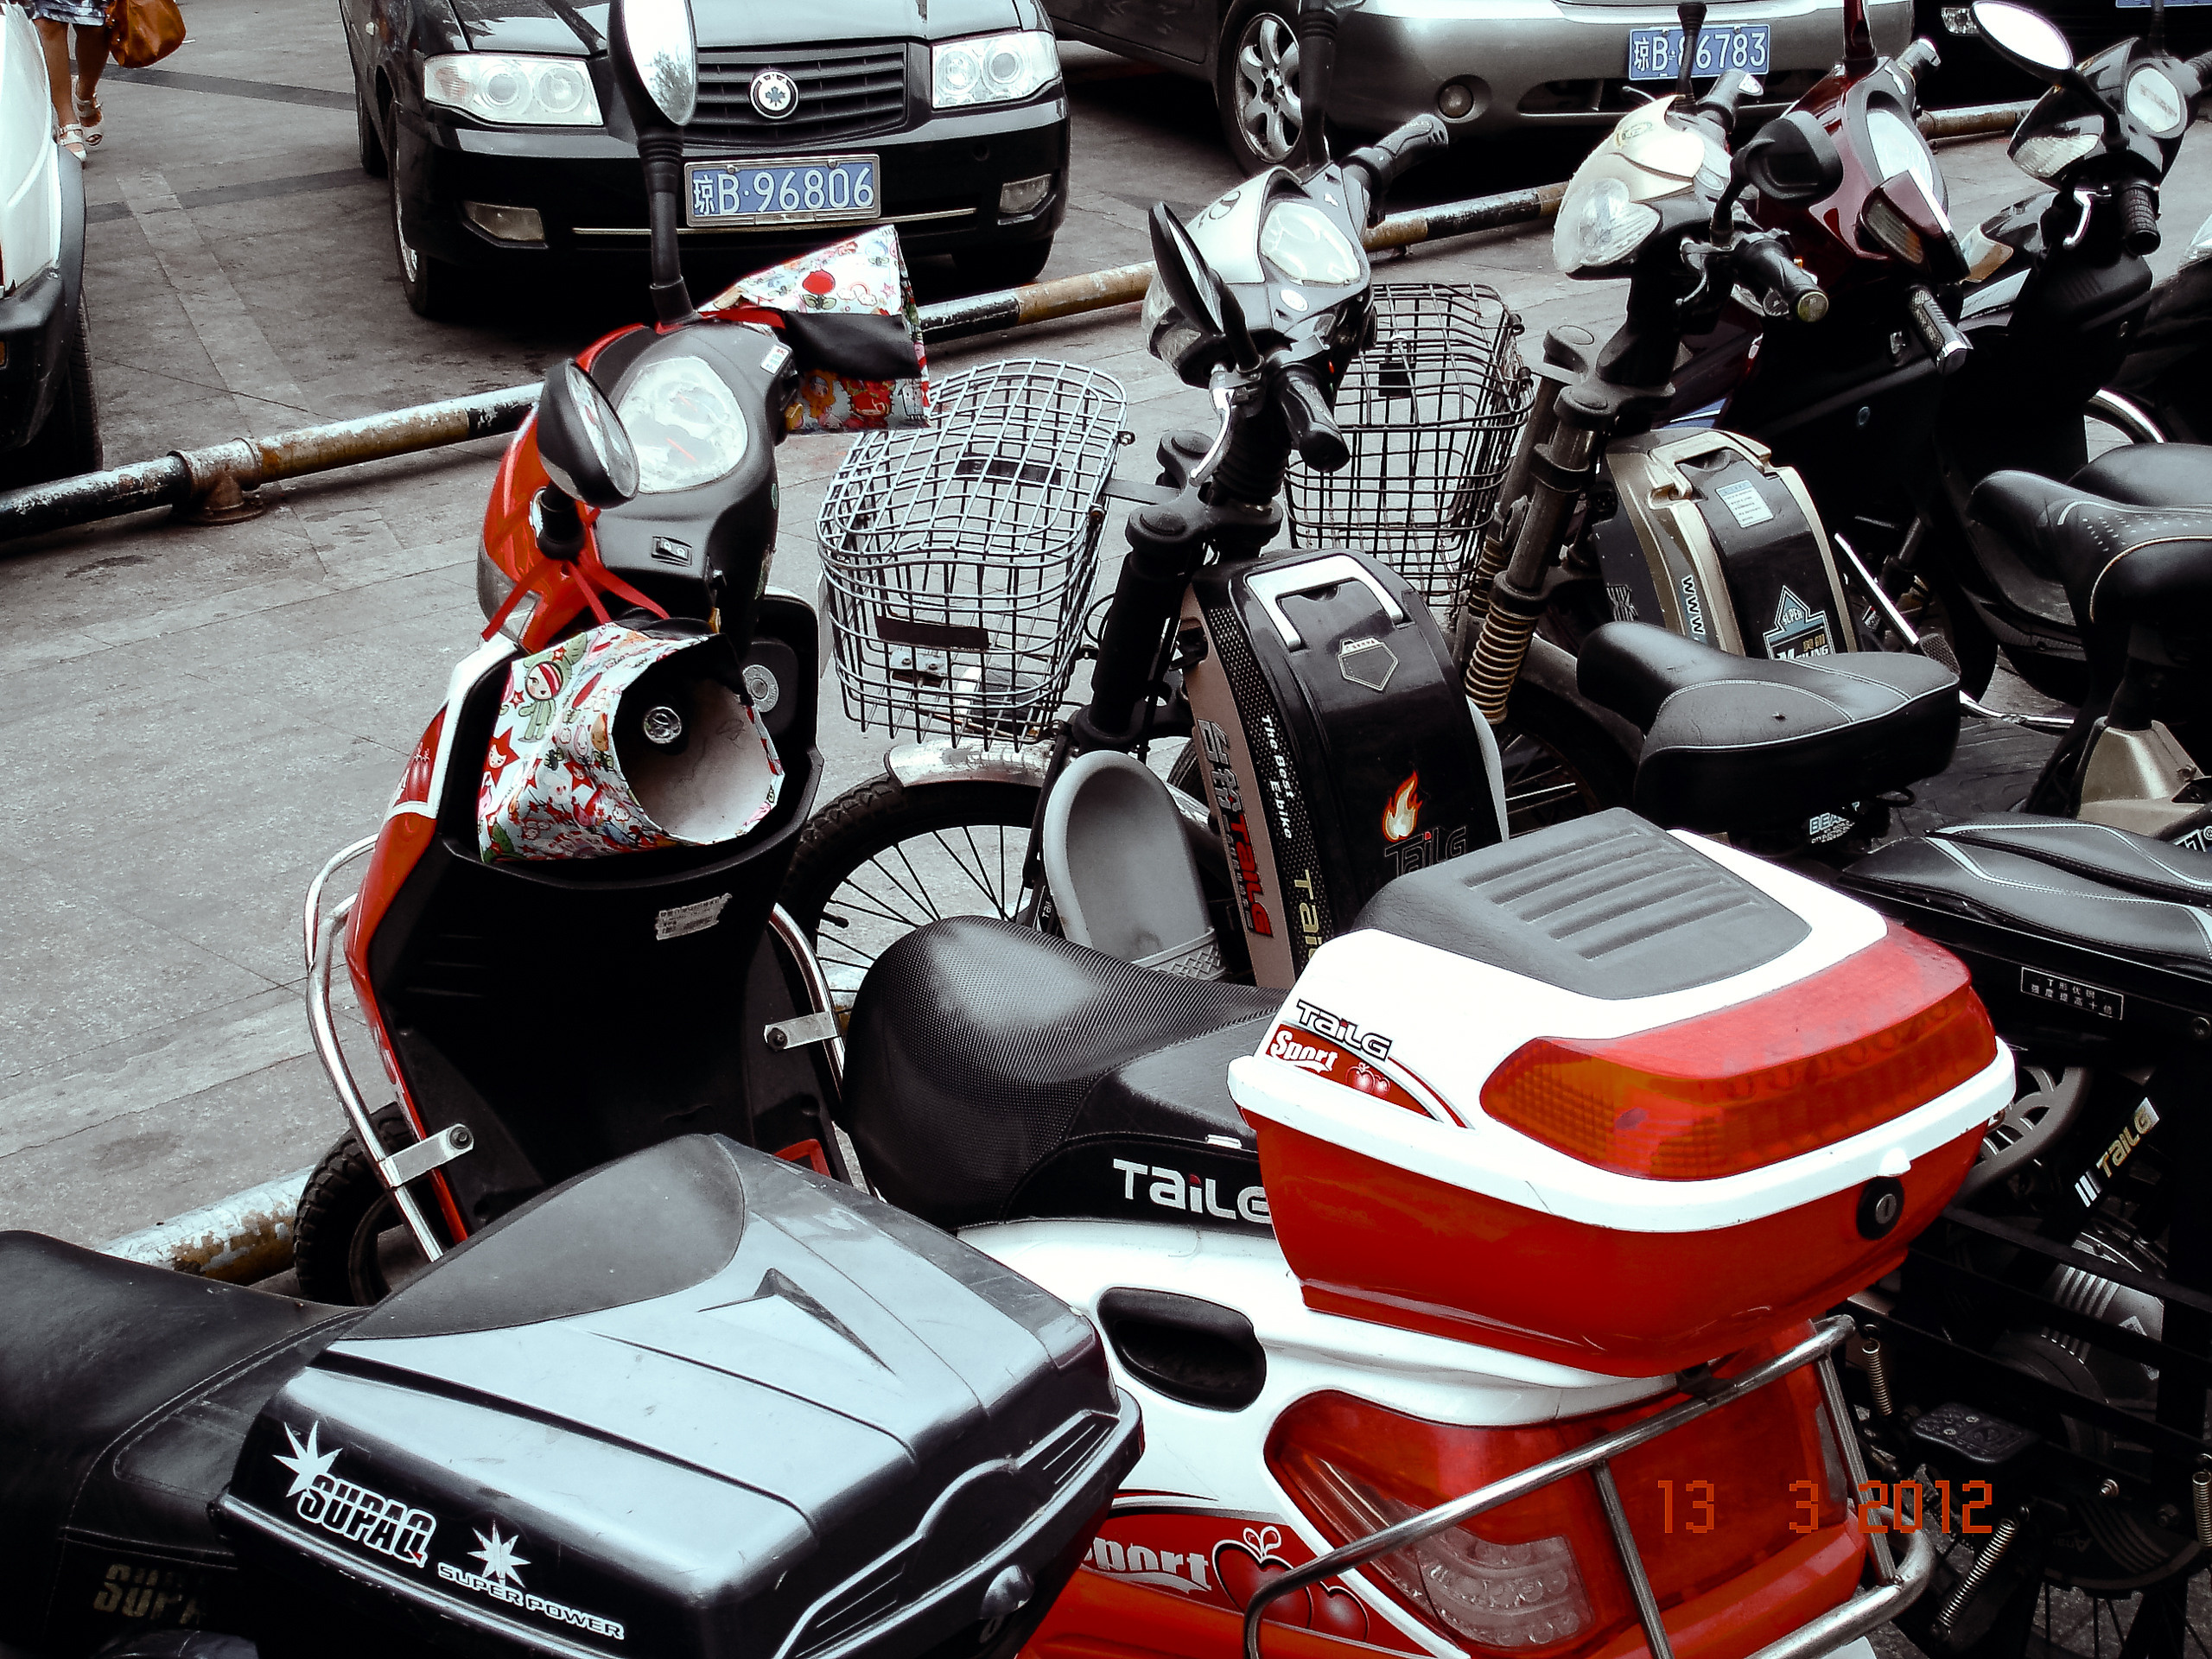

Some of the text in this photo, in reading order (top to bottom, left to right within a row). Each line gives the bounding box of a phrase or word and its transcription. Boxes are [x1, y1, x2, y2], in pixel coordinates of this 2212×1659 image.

[1262, 715, 1294, 799] The Best
[1270, 779, 1293, 840] E-bike
[1270, 1029, 1339, 1068] Sport
[297, 1474, 437, 1568] SUPAQ
[1084, 1536, 1211, 1590] port
[437, 1561, 625, 1640] SUPER POWER
